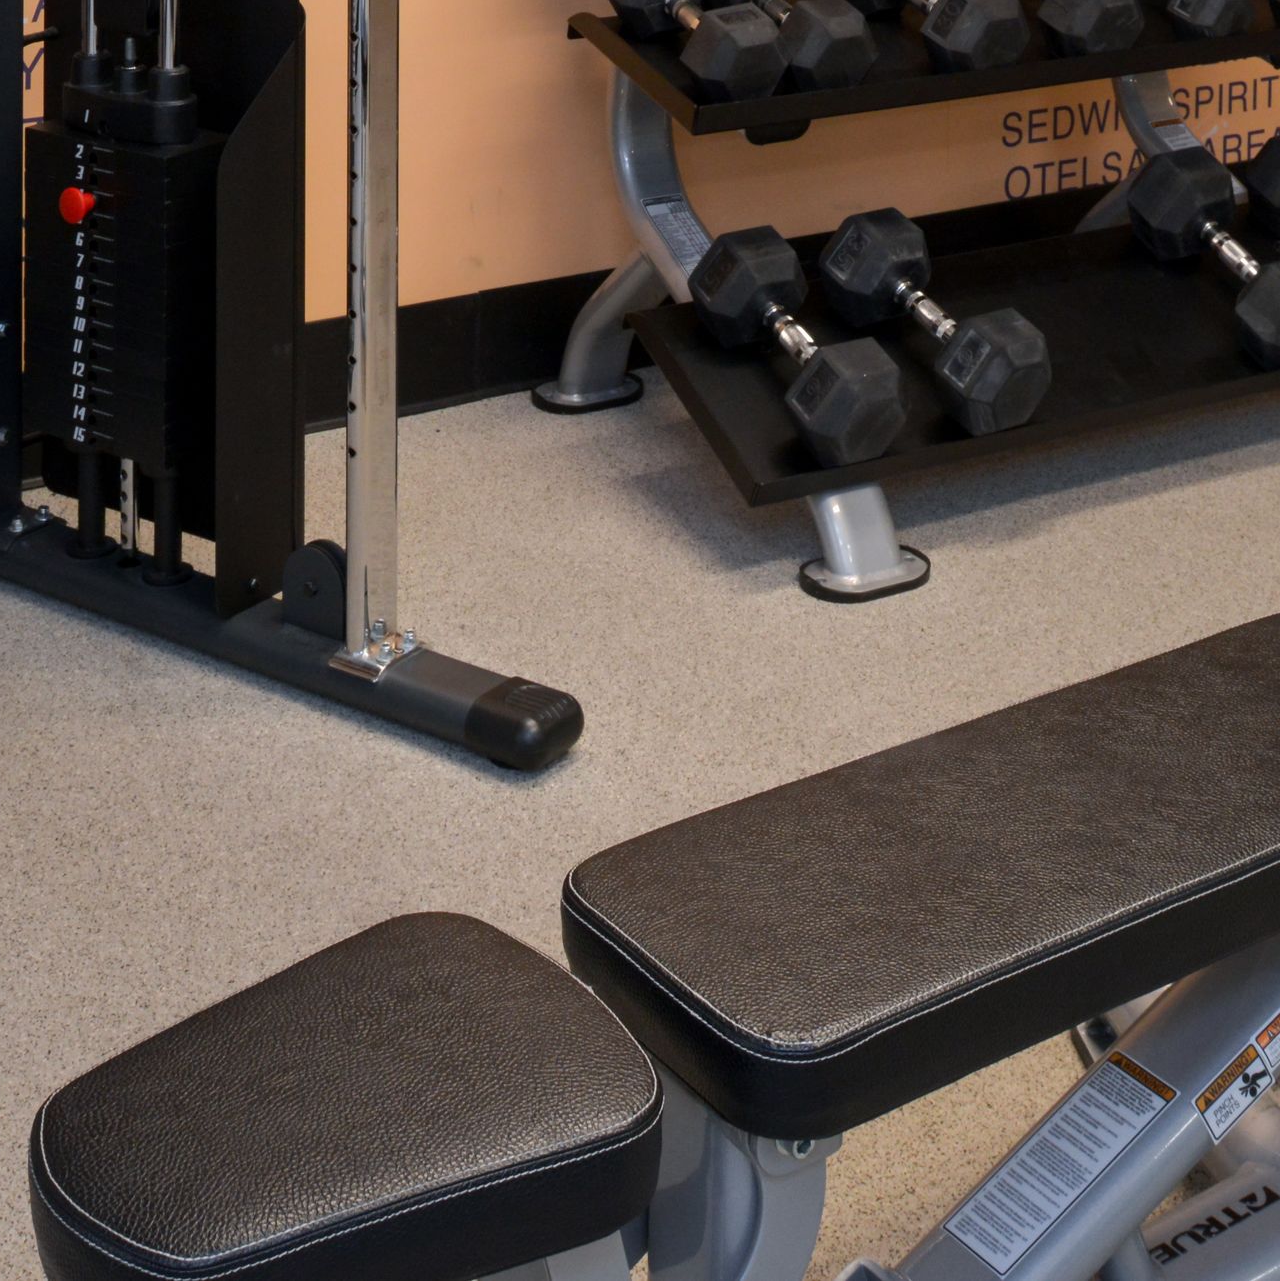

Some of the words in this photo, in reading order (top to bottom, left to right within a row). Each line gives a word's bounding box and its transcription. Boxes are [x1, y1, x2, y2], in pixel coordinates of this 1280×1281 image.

[75, 144, 84, 159] 2
[75, 165, 84, 180] 3
[75, 232, 84, 247] 6
[76, 253, 84, 268] 7
[75, 275, 84, 290] 8
[75, 295, 85, 311] 9
[73, 316, 86, 332] 10
[73, 338, 83, 354] 11
[72, 361, 85, 377] 12
[72, 383, 86, 400] 13
[73, 404, 86, 421] 14
[73, 426, 86, 443] 15
[1149, 1206, 1251, 1265] TRUE
